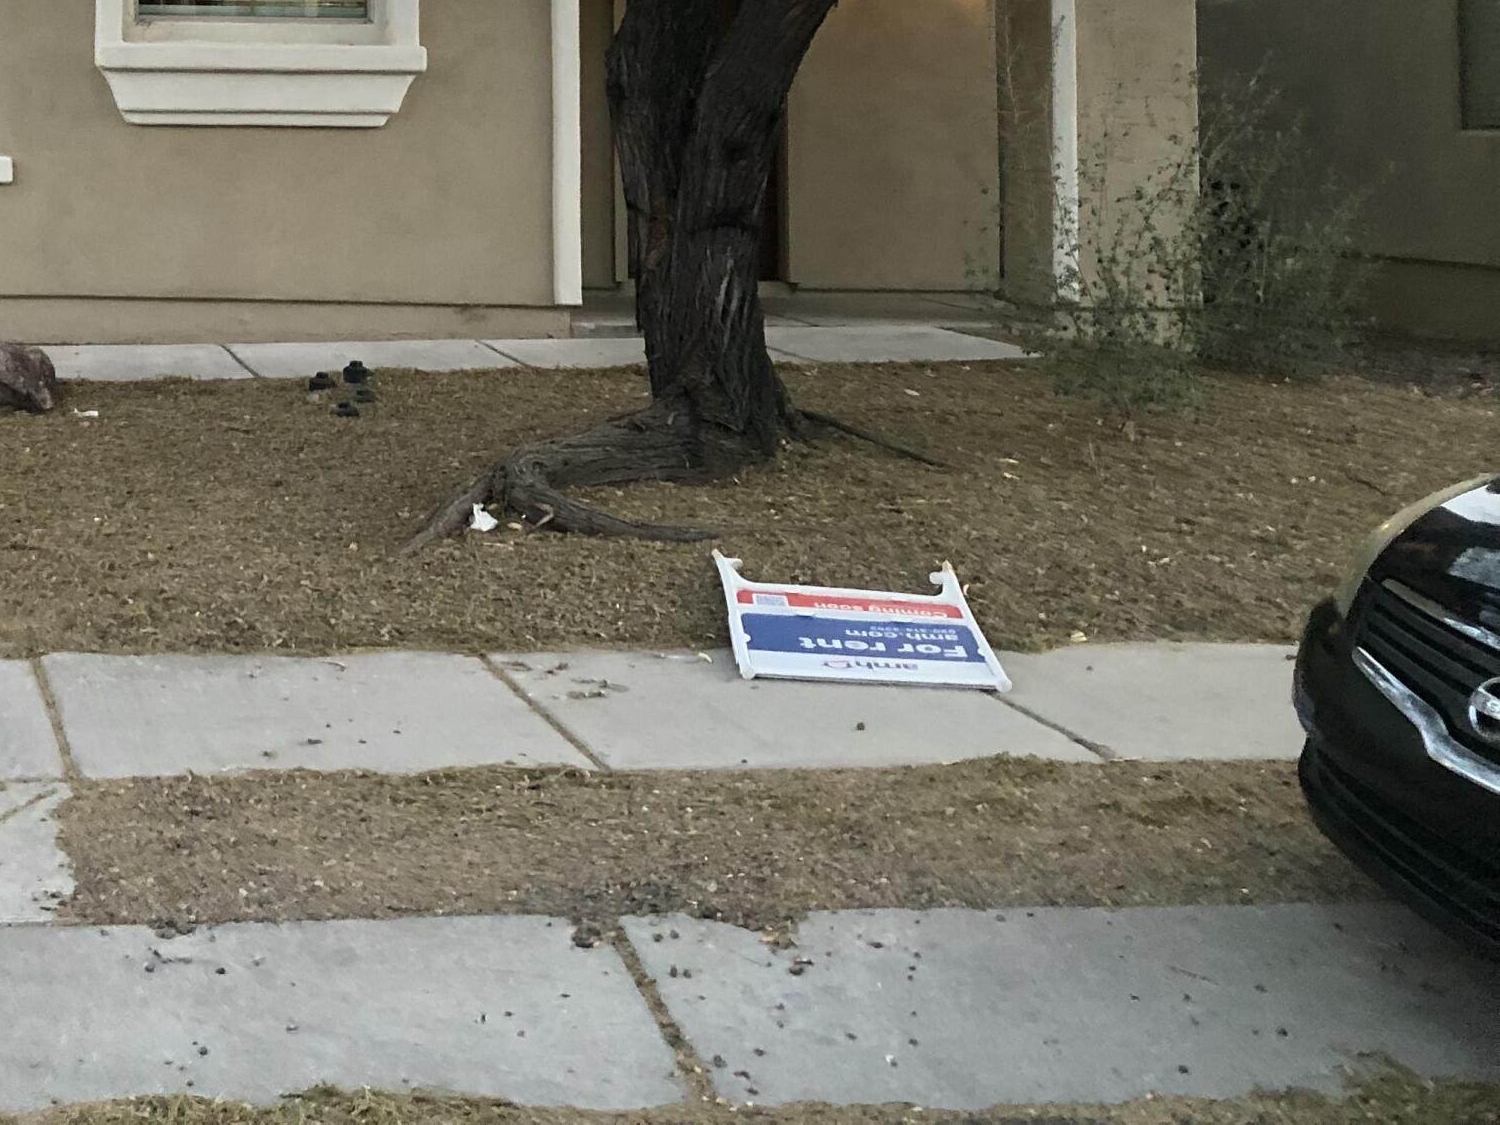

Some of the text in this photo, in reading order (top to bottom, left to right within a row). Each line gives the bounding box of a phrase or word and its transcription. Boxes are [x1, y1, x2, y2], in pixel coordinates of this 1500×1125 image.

[845, 629, 959, 641] amh.com
[799, 636, 968, 657] For rent
